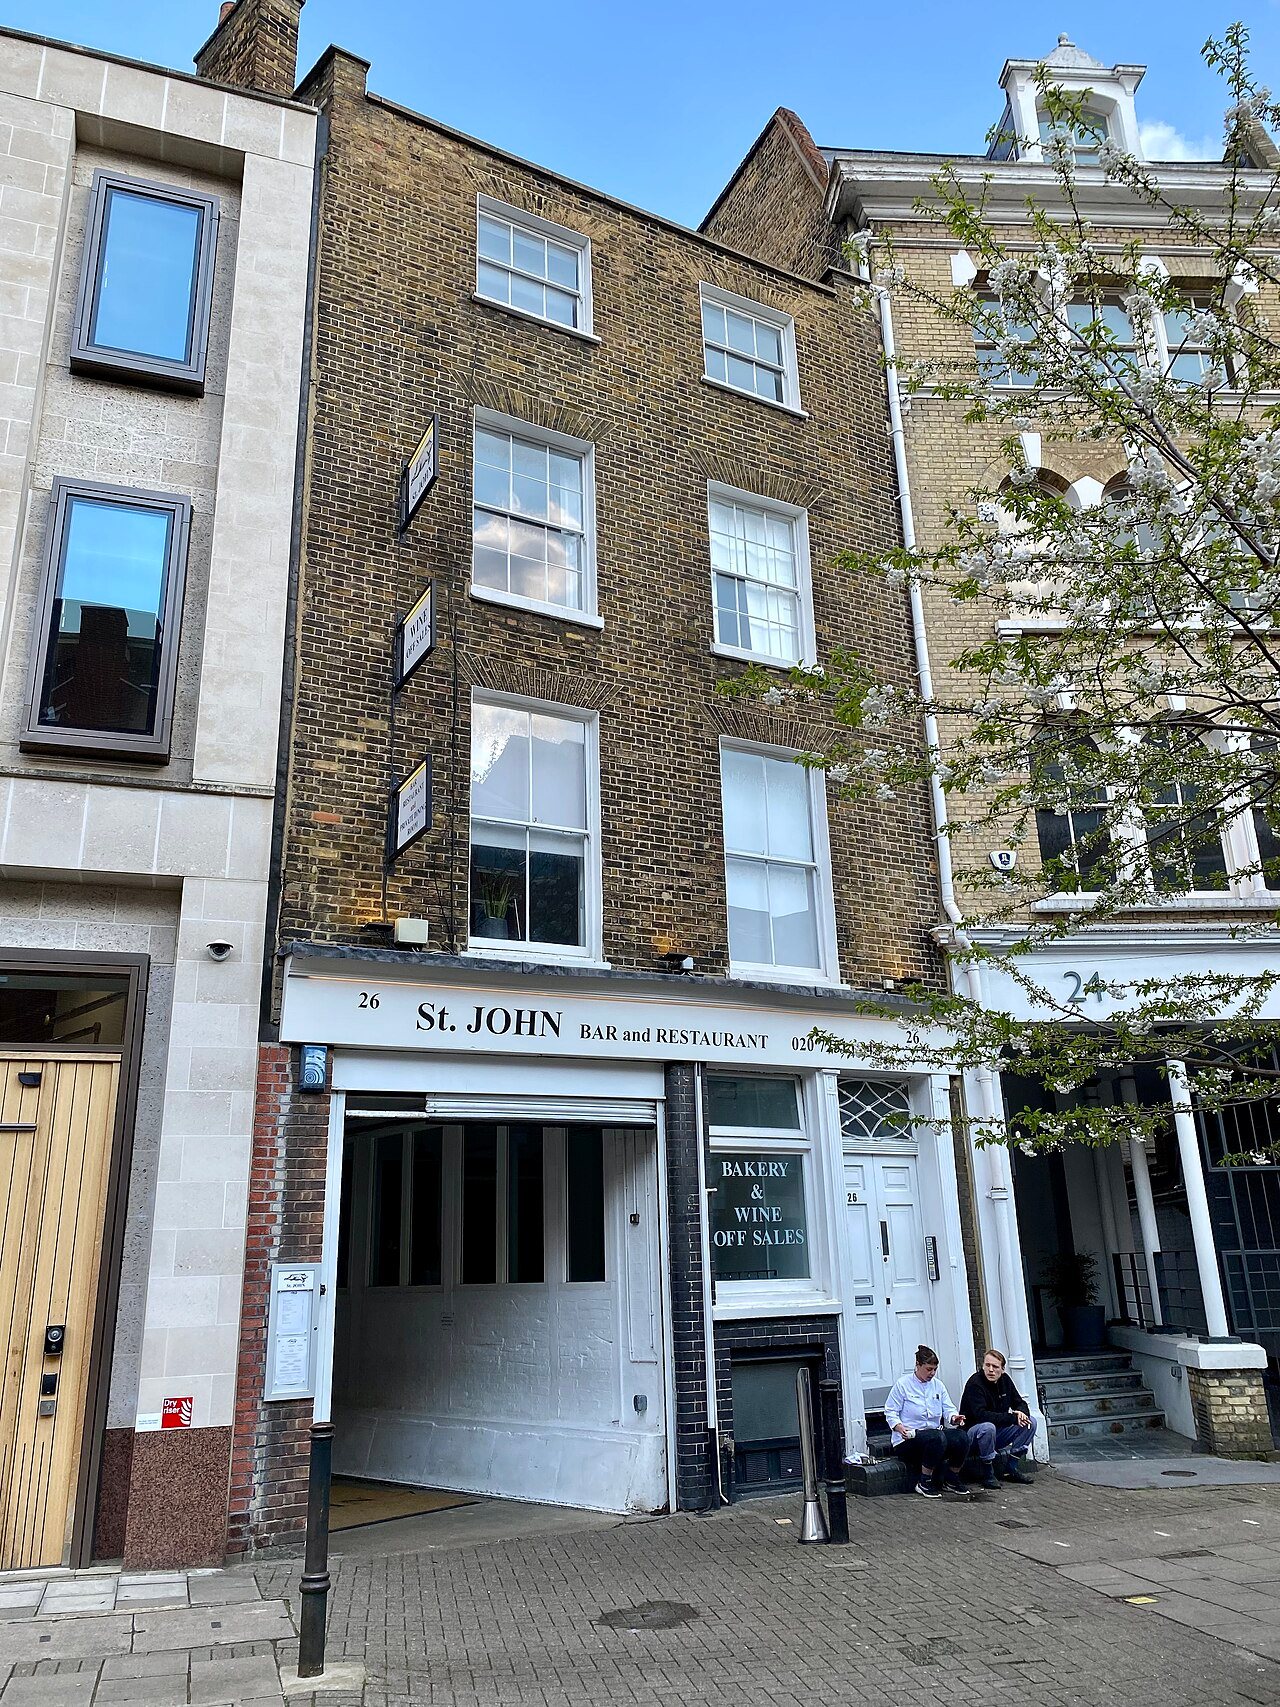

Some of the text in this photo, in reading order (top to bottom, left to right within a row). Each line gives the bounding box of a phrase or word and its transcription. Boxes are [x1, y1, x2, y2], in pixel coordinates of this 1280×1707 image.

[409, 608, 428, 638] WINE
[1063, 970, 1103, 1003] 24
[358, 991, 381, 1010] 26
[416, 1002, 457, 1032] St.
[466, 1005, 563, 1038] JOHN
[580, 1023, 618, 1042] BAR
[622, 1026, 651, 1043] and
[656, 1027, 769, 1050] RESTAURANT
[791, 1036, 815, 1052] 020
[905, 1030, 920, 1045] 26
[721, 1161, 789, 1178] BAKERY
[750, 1183, 764, 1200] &
[847, 1192, 858, 1203] 26
[734, 1206, 783, 1223] WINE
[713, 1229, 805, 1247] OFF SALES
[164, 1399, 177, 1407] Dry
